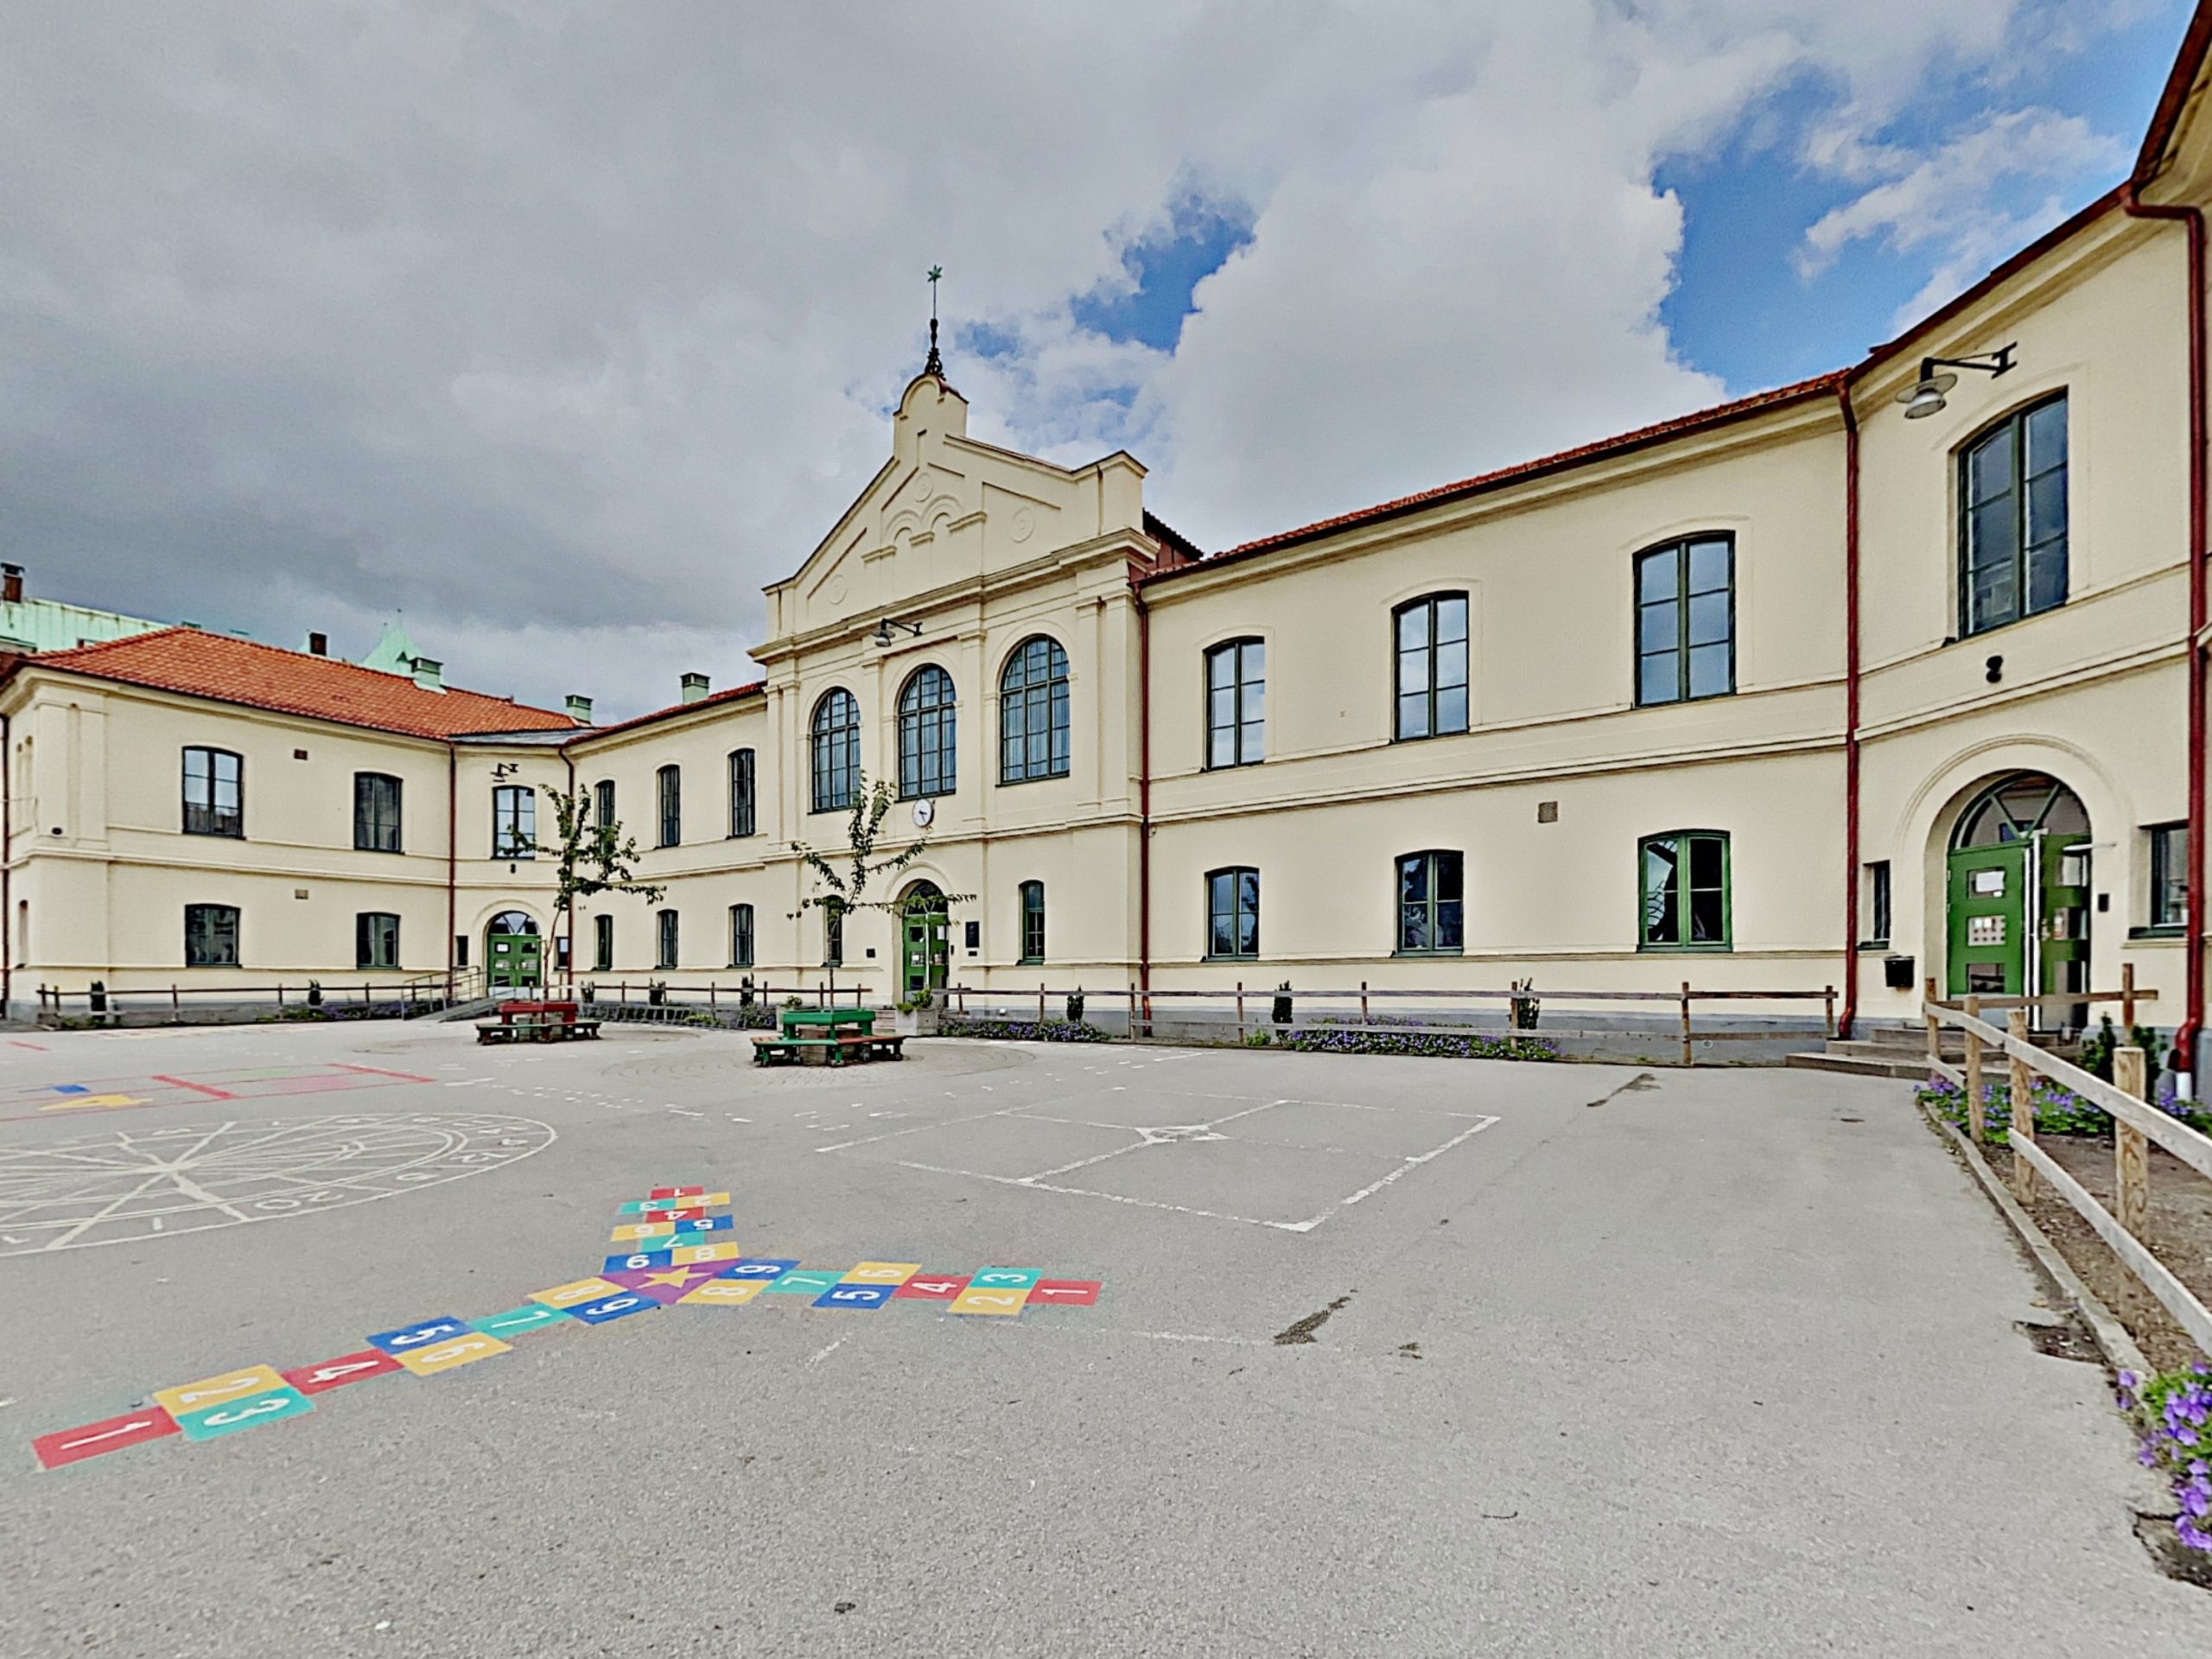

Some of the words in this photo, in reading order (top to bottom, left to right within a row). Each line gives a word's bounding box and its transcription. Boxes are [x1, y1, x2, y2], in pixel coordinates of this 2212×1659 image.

[673, 1188, 685, 1197] 1
[254, 1191, 345, 1210] 20
[639, 1200, 659, 1211] 3
[695, 1196, 711, 1205] 2
[664, 1210, 689, 1221] 4
[693, 1219, 714, 1230] 5
[663, 1235, 684, 1249] 7
[695, 1247, 716, 1262] 8
[781, 1276, 827, 1287] 7
[981, 1273, 1028, 1284] 3
[552, 1284, 605, 1301] 8
[700, 1286, 750, 1297] 8
[911, 1281, 957, 1294] 4
[1040, 1287, 1089, 1296] 1
[831, 1289, 880, 1301] 5
[966, 1294, 1016, 1306] 2
[491, 1310, 552, 1329] 7
[391, 1324, 455, 1346] 5
[307, 1360, 380, 1383] 4
[179, 1376, 261, 1404] 2
[203, 1397, 290, 1427] 3
[60, 1421, 153, 1450] 1
